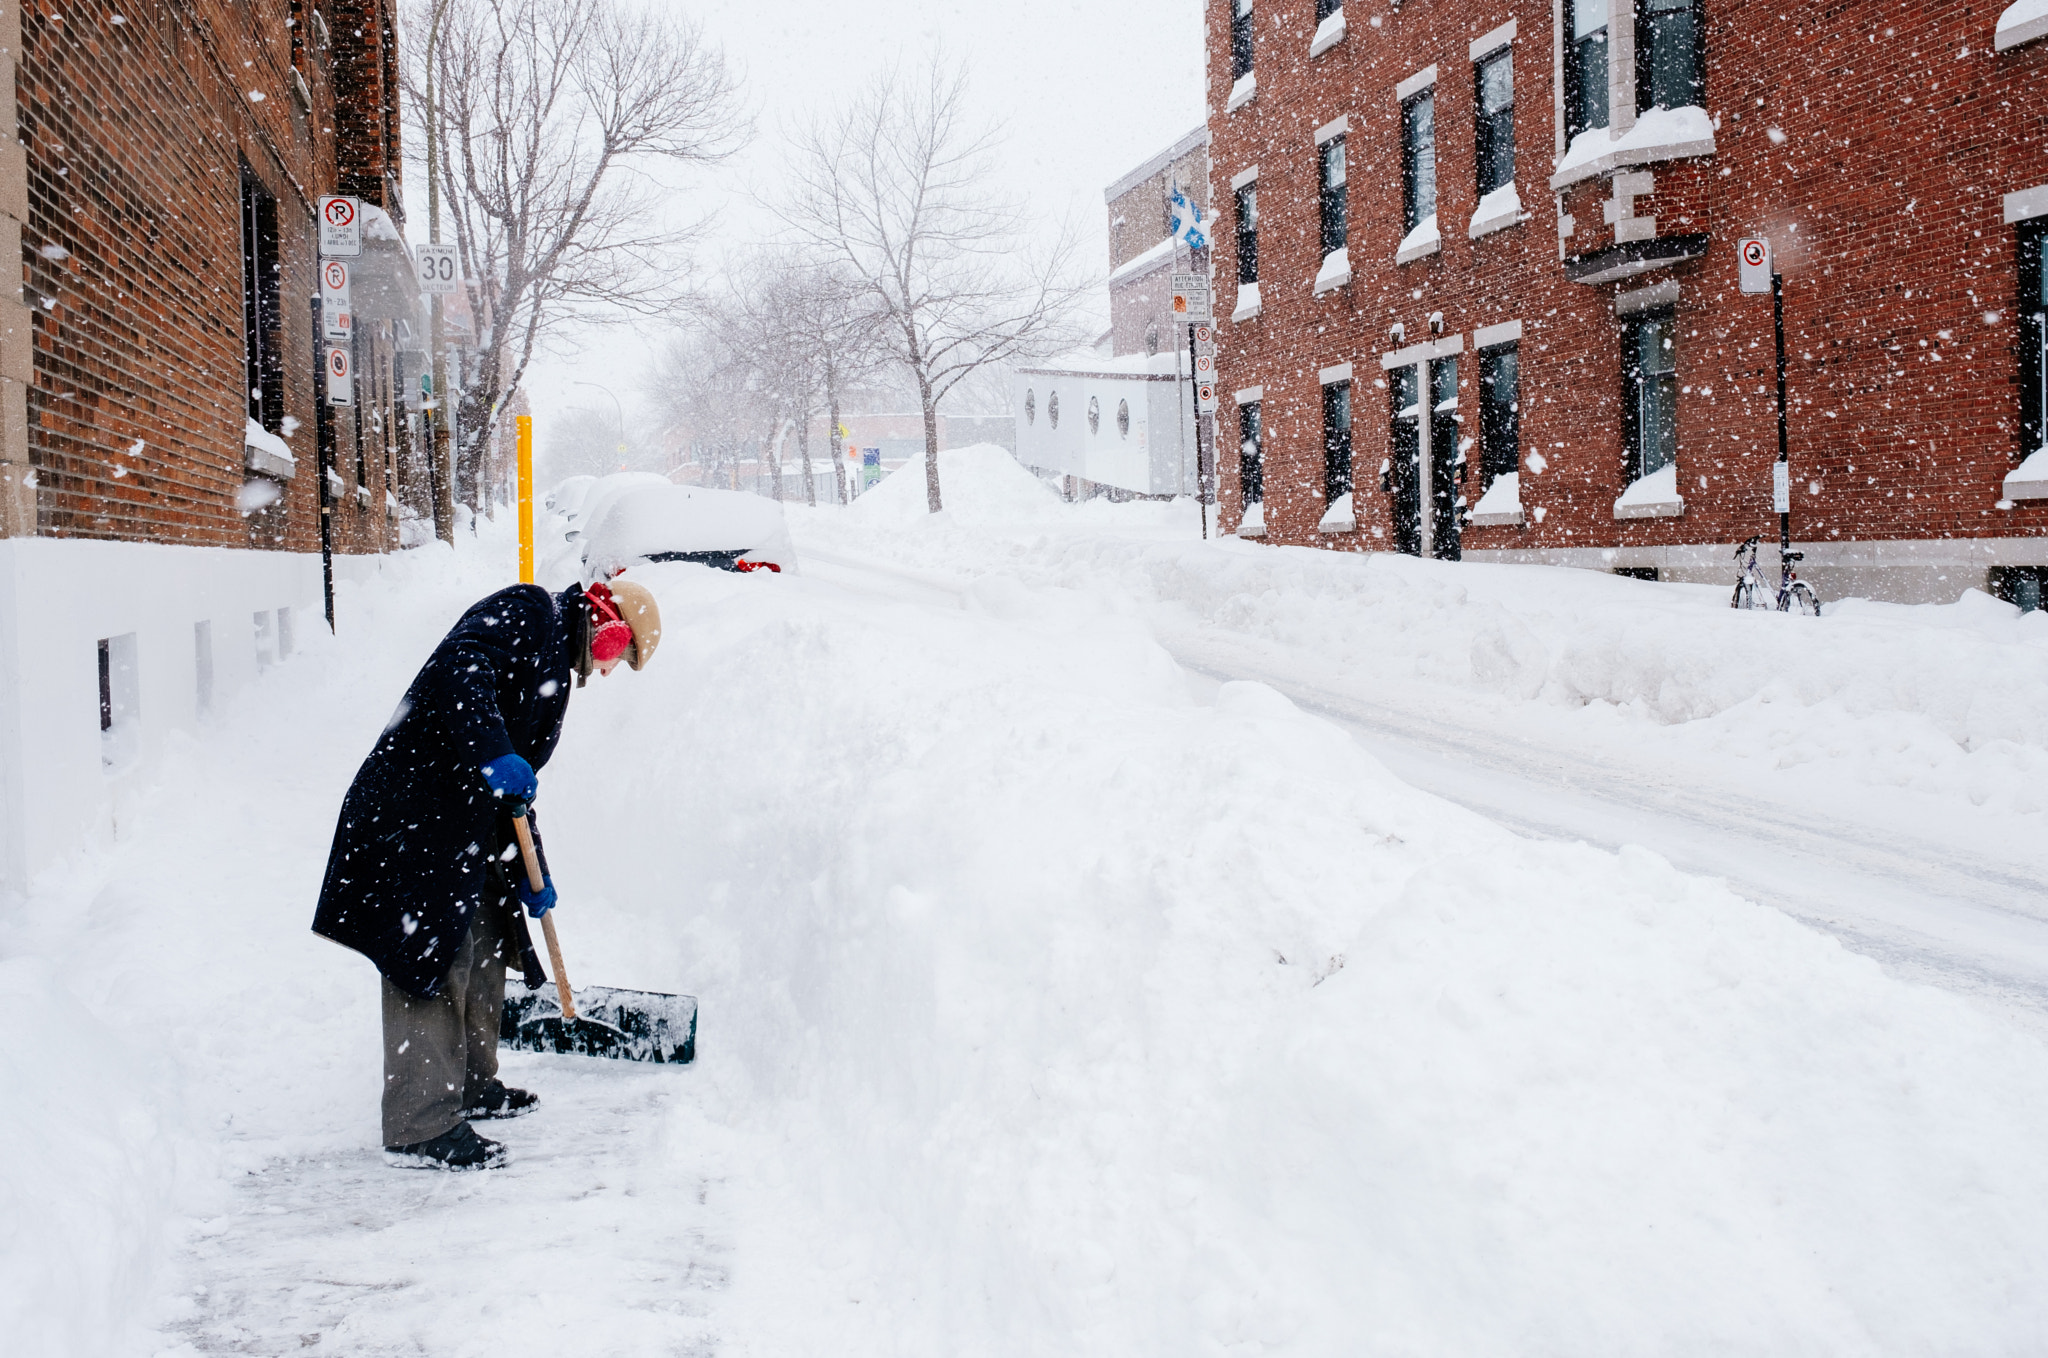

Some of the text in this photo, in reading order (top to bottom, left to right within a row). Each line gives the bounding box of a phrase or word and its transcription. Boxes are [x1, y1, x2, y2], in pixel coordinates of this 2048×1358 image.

[336, 206, 345, 220] P
[420, 247, 453, 255] MAXIMUM
[422, 256, 453, 281] 30
[422, 283, 453, 291] SECTEUR
